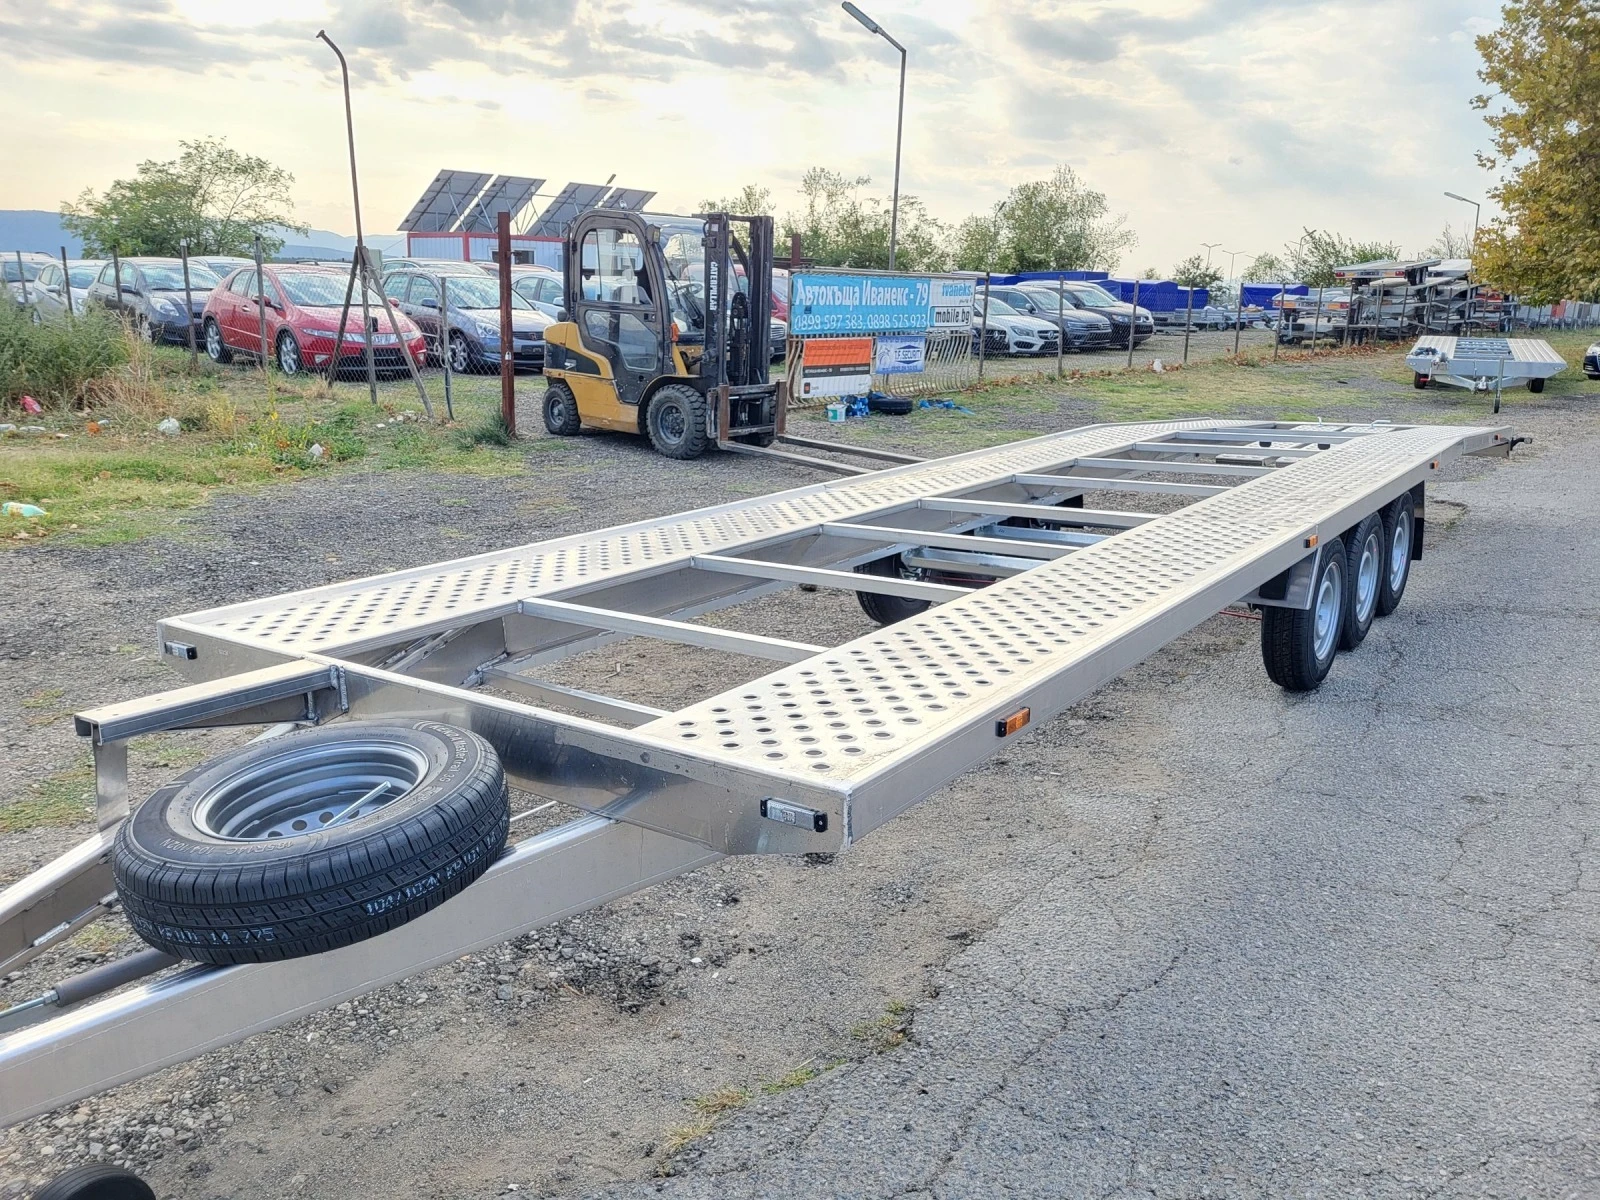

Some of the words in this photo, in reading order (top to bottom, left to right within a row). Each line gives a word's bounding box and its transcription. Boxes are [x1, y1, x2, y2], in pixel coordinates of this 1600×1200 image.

[710, 261, 718, 311] CATERPILLAR
[795, 279, 859, 311] Автокъща
[861, 280, 908, 306] Иванекс
[915, 282, 929, 306] 79
[823, 314, 841, 329] 597
[867, 314, 891, 329] 0898
[892, 314, 909, 328] 525
[910, 314, 927, 328] 923
[935, 309, 970, 324] mobile.bg
[159, 837, 217, 856] 104/102N
